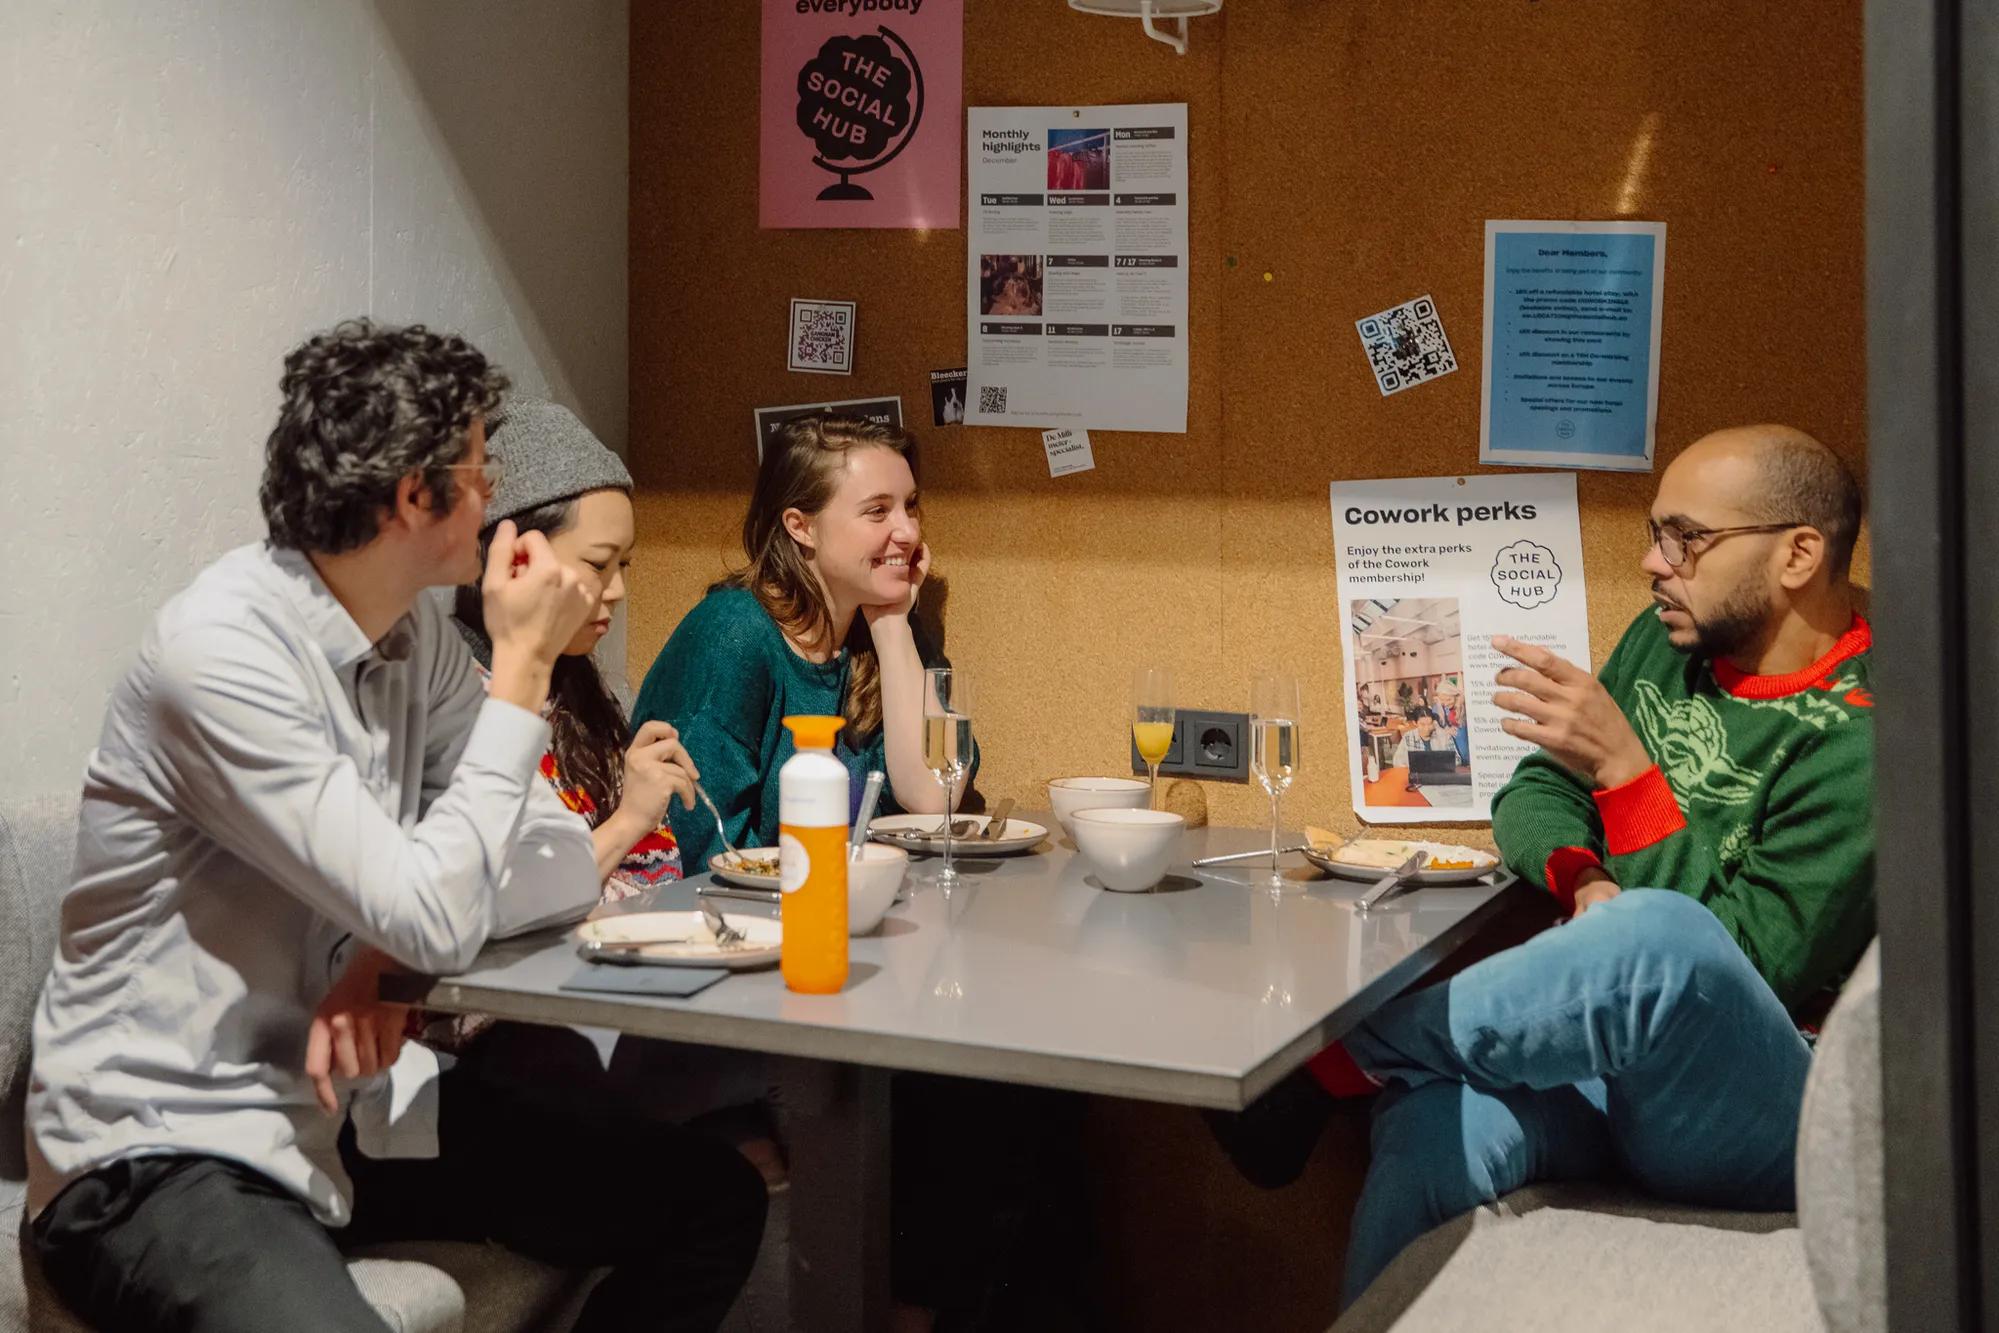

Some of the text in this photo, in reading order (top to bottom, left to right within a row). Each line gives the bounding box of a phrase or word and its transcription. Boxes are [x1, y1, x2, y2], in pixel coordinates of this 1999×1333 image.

[796, 0, 922, 16] everybody
[842, 52, 892, 88] THE
[807, 71, 897, 127] SOCIAL
[812, 107, 868, 145] HUB
[982, 129, 1029, 140] Monthly
[1115, 131, 1131, 139] Mon
[982, 142, 1041, 153] highlights
[983, 196, 997, 204] Tue
[1049, 196, 1067, 205] Wed
[1538, 249, 1560, 257] Dear
[1345, 501, 1537, 526] Cowork perks
[1347, 543, 1472, 557] Enjoy the extra perks
[1348, 558, 1430, 569] of the Cowork
[1509, 553, 1541, 564] THE
[1349, 572, 1426, 584] membership!
[1497, 569, 1556, 581] SOCIAL
[1510, 585, 1545, 597] HUB
